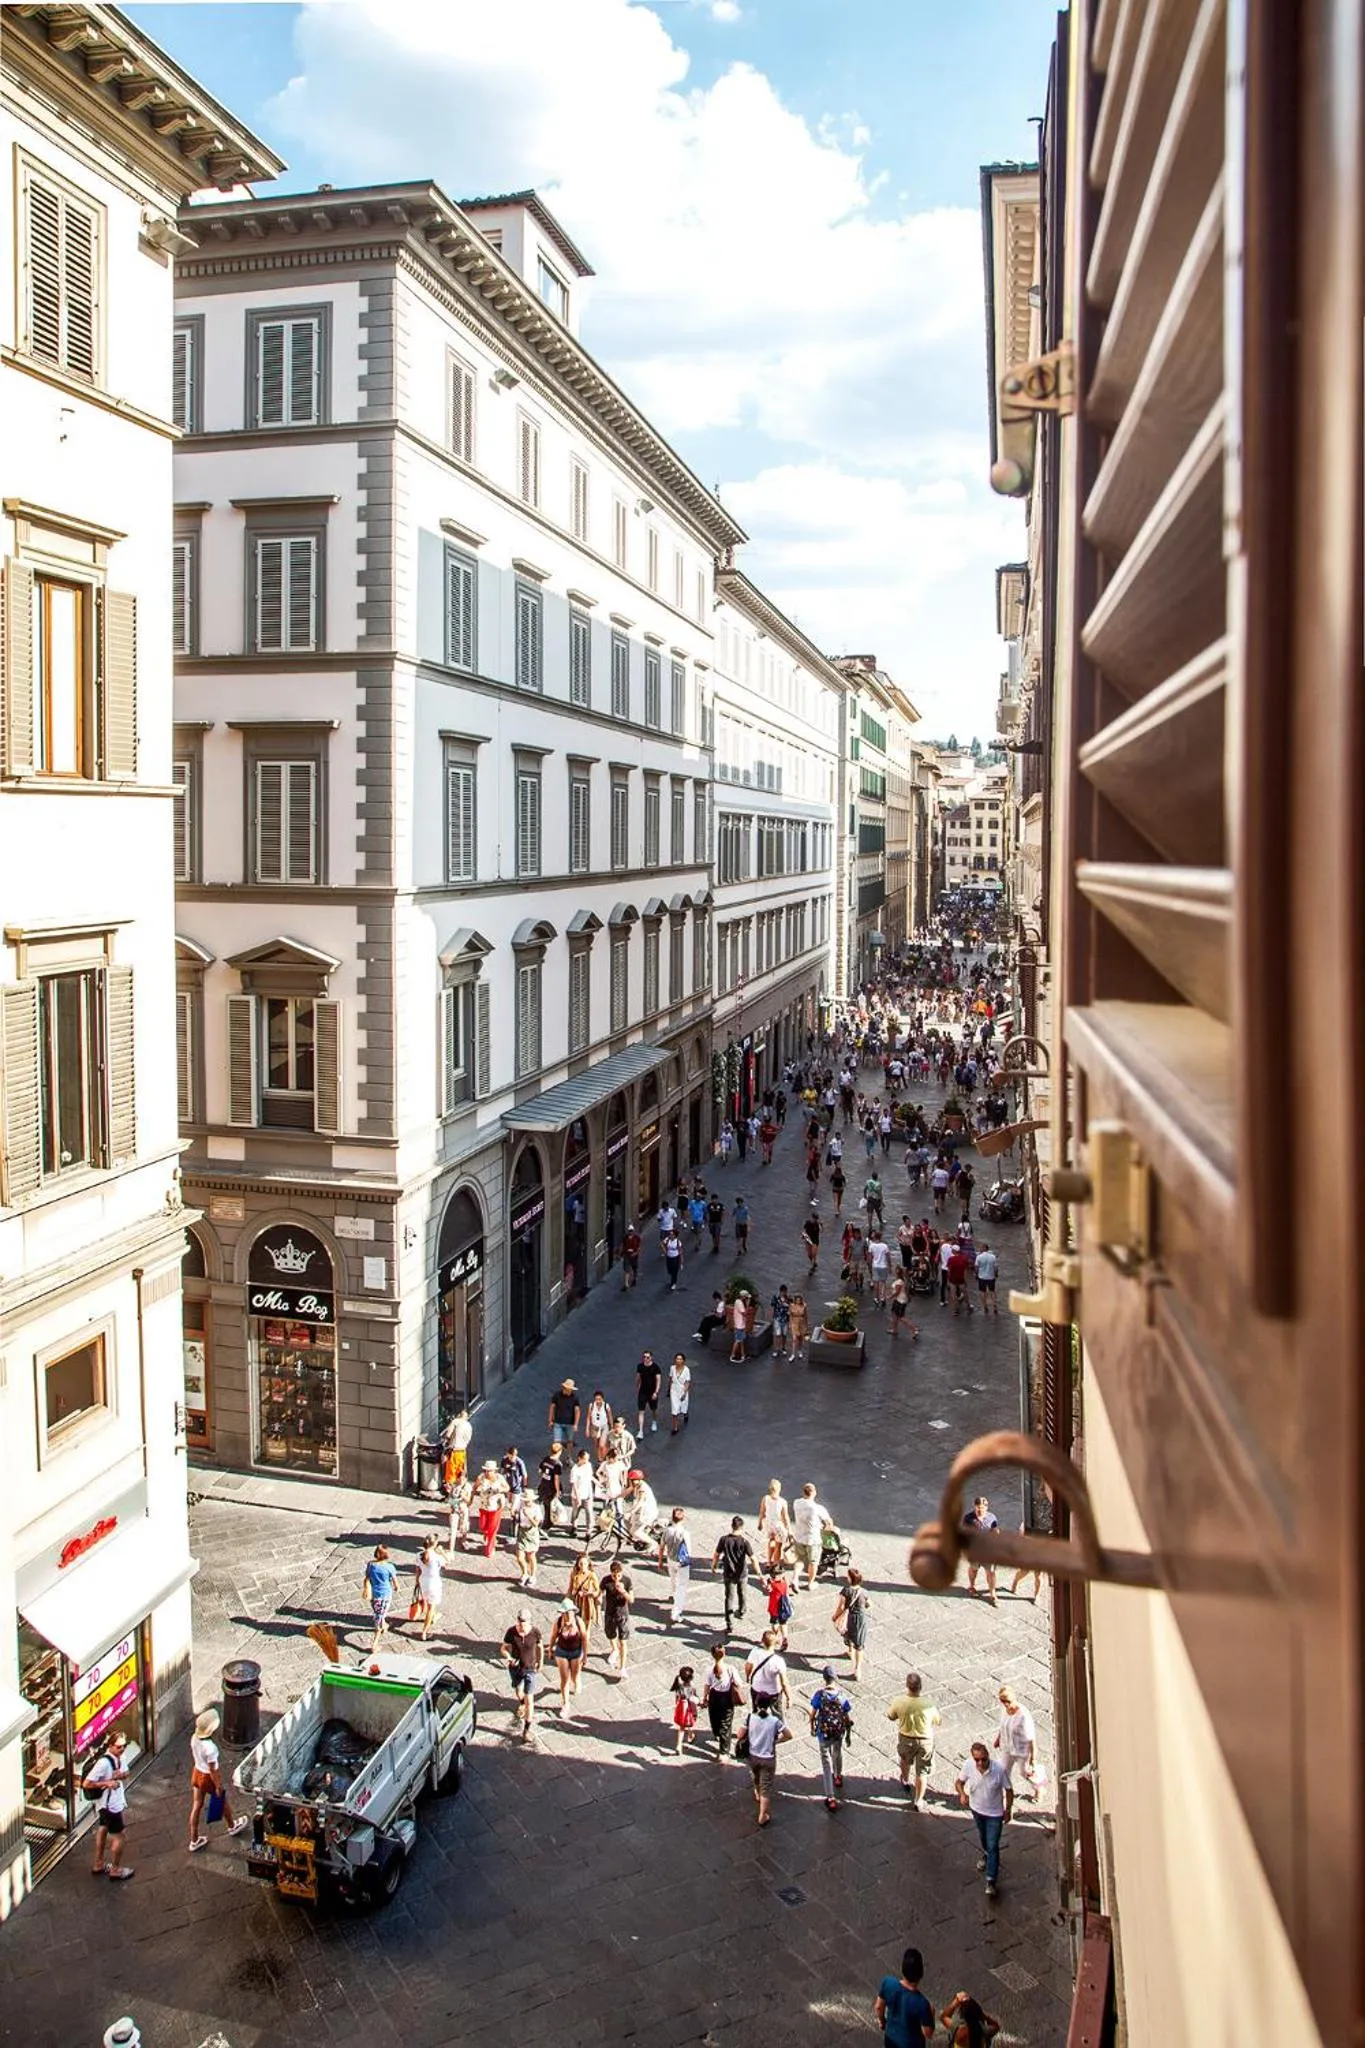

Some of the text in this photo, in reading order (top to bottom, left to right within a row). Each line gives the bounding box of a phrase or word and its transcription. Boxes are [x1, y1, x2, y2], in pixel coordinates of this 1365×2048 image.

[295, 1295, 328, 1320] Bag
[87, 1640, 130, 1690] 70 70
[88, 1692, 102, 1715] 70
[117, 1665, 131, 1688] 70
